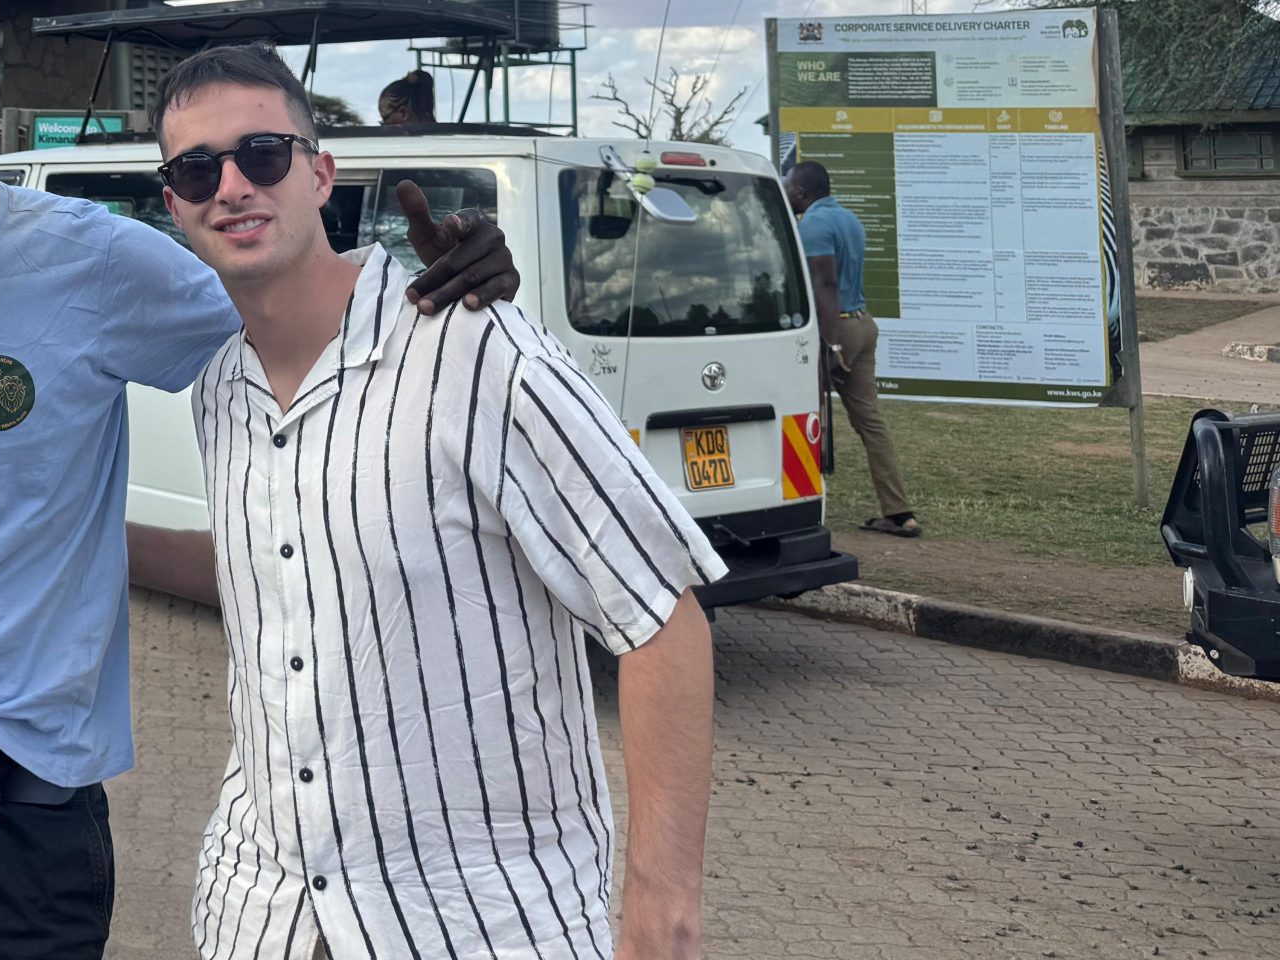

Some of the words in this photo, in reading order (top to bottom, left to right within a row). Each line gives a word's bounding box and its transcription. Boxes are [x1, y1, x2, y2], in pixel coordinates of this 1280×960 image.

[834, 23, 892, 32] CORPORATE
[893, 22, 934, 32] SERVICE
[935, 21, 982, 31] DELIVERY
[983, 20, 1030, 30] CHARTER
[797, 61, 825, 71] WHO
[797, 72, 815, 82] WE
[817, 72, 841, 82] ARE
[38, 123, 82, 133] Welcom
[1046, 389, 1103, 399] www.kws.go.ke
[694, 430, 725, 456] KDQ
[690, 458, 731, 485] 047D
